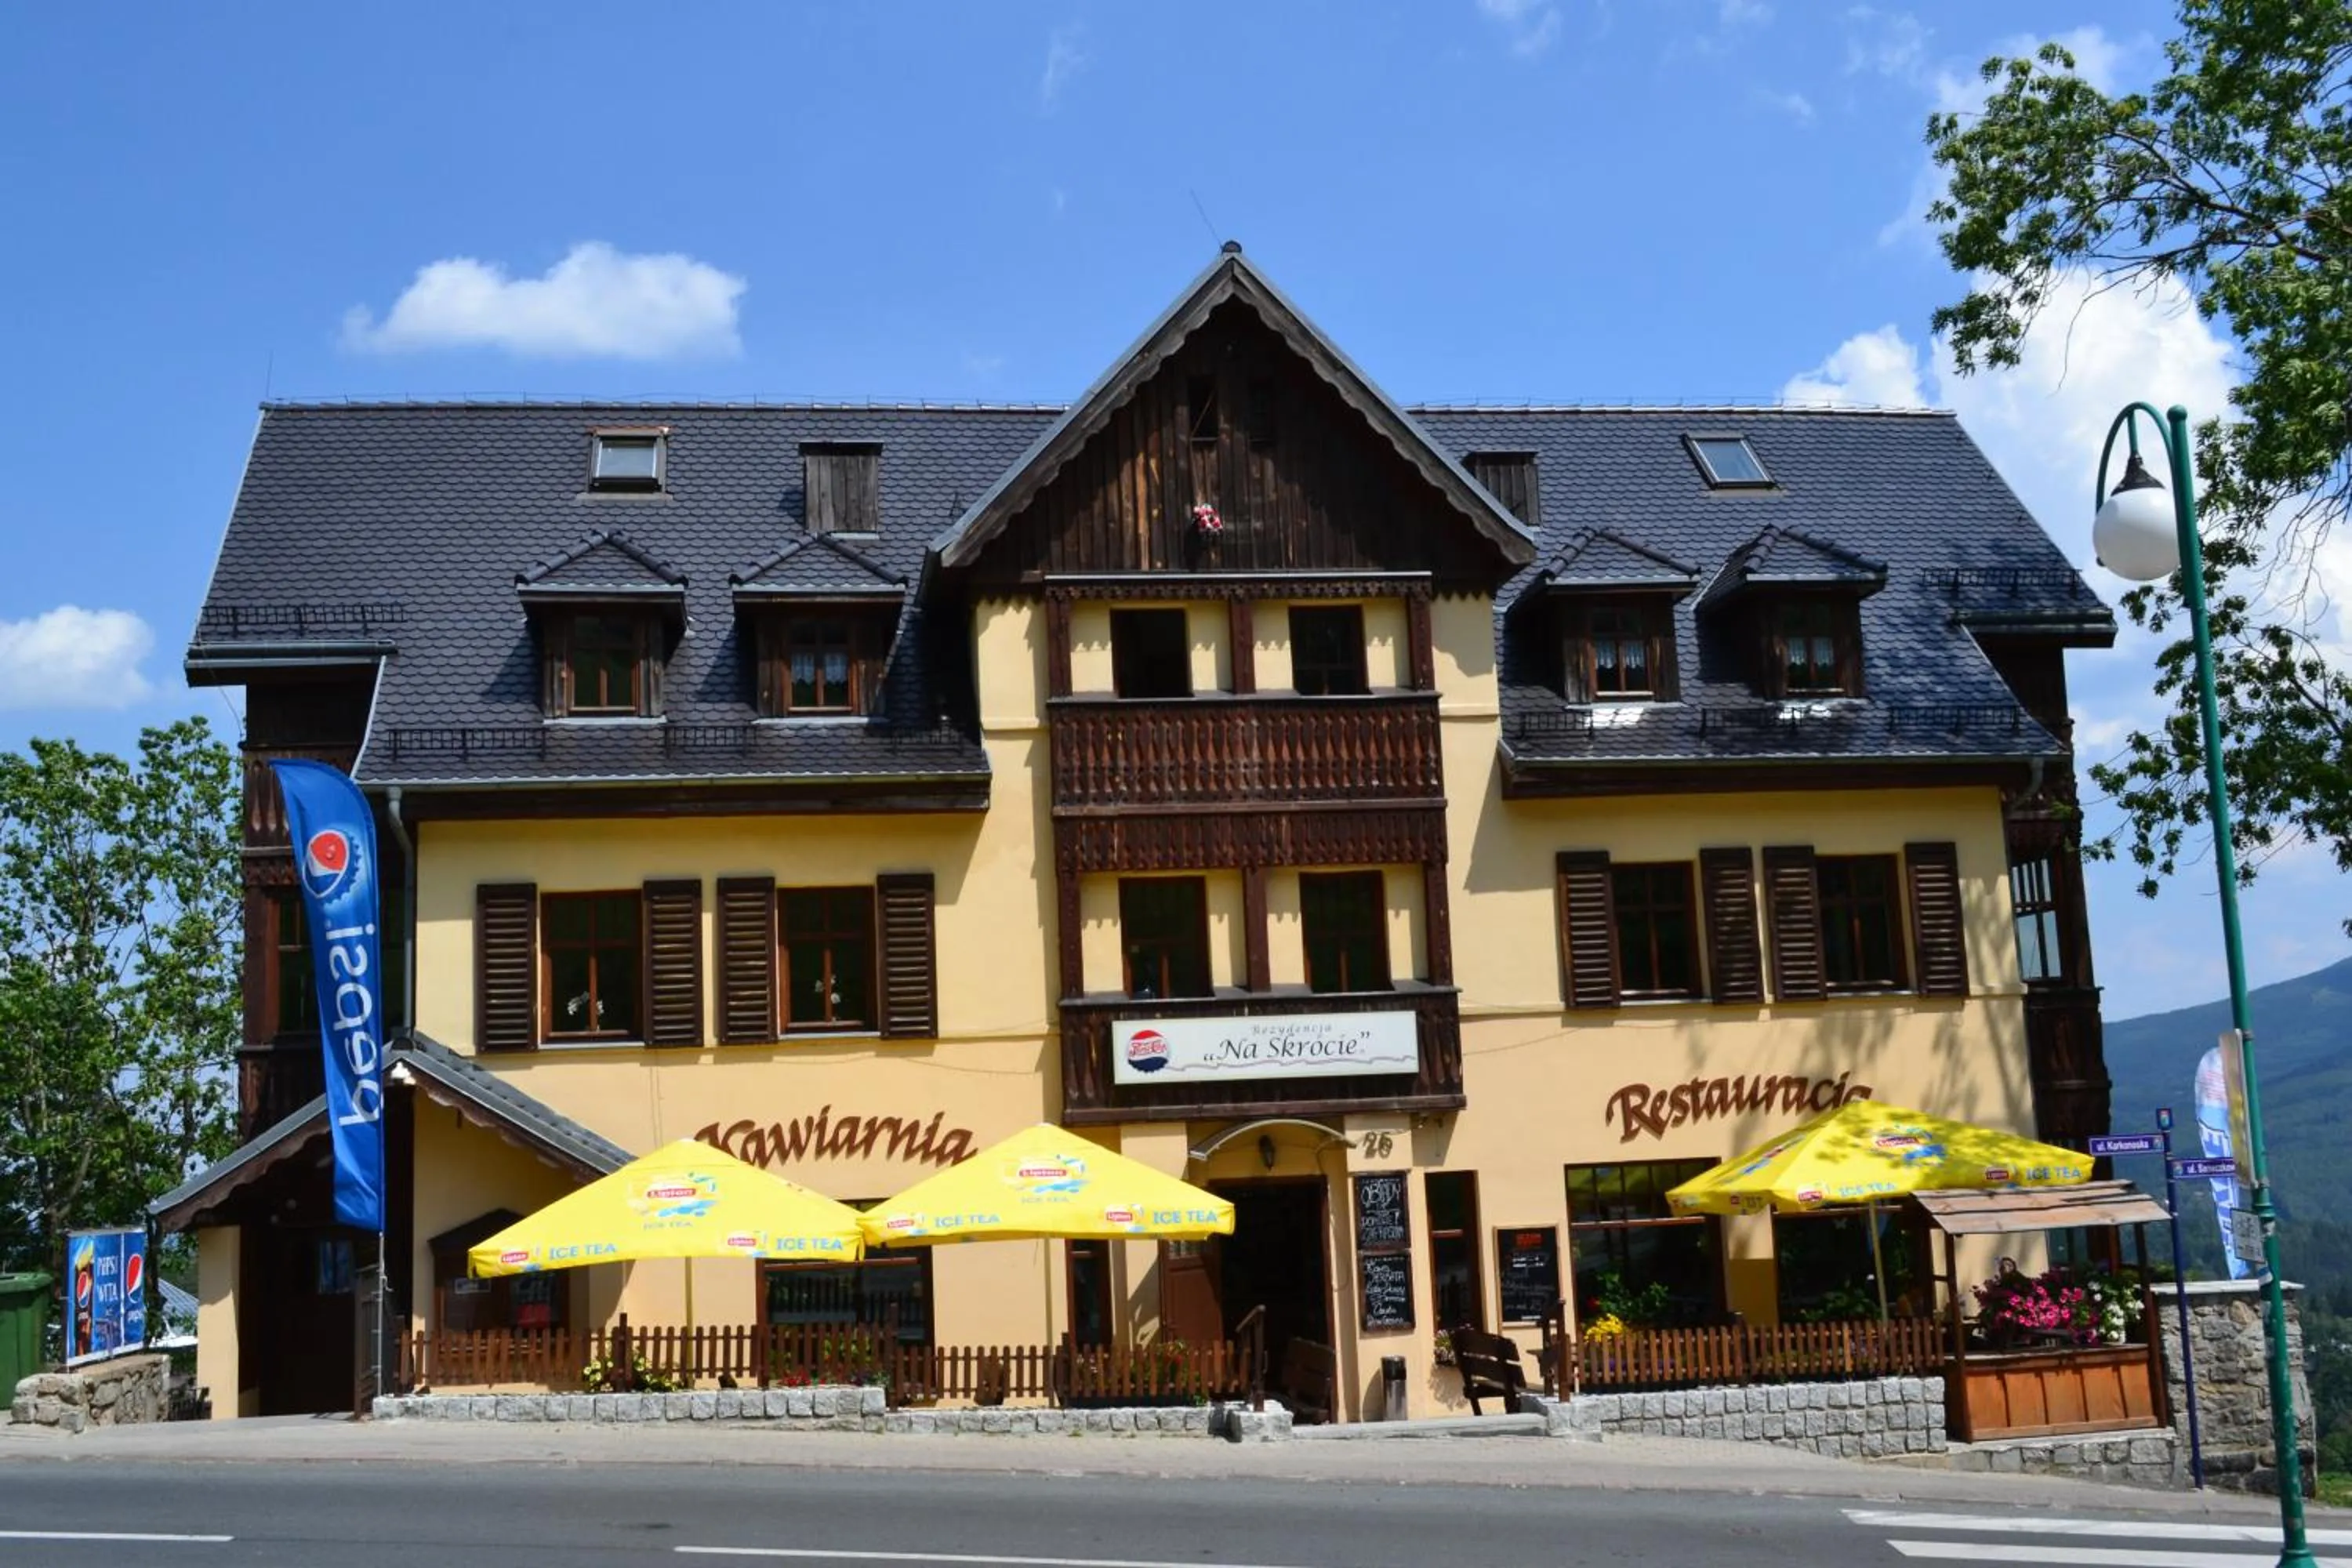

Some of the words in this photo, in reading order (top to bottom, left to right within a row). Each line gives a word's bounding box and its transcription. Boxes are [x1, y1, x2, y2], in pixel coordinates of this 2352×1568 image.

[693, 1103, 979, 1171] Kawiarnia
[2026, 1167, 2051, 1180] ICE
[2053, 1166, 2082, 1179] TEA
[935, 1216, 964, 1229] ICE
[969, 1214, 1000, 1225] TEA
[1153, 1210, 1182, 1224] ICE
[1186, 1210, 1218, 1223] TEA
[776, 1237, 806, 1250] ICE
[811, 1237, 844, 1250] TEA
[550, 1246, 579, 1261] ICE
[584, 1243, 617, 1255] TEA
